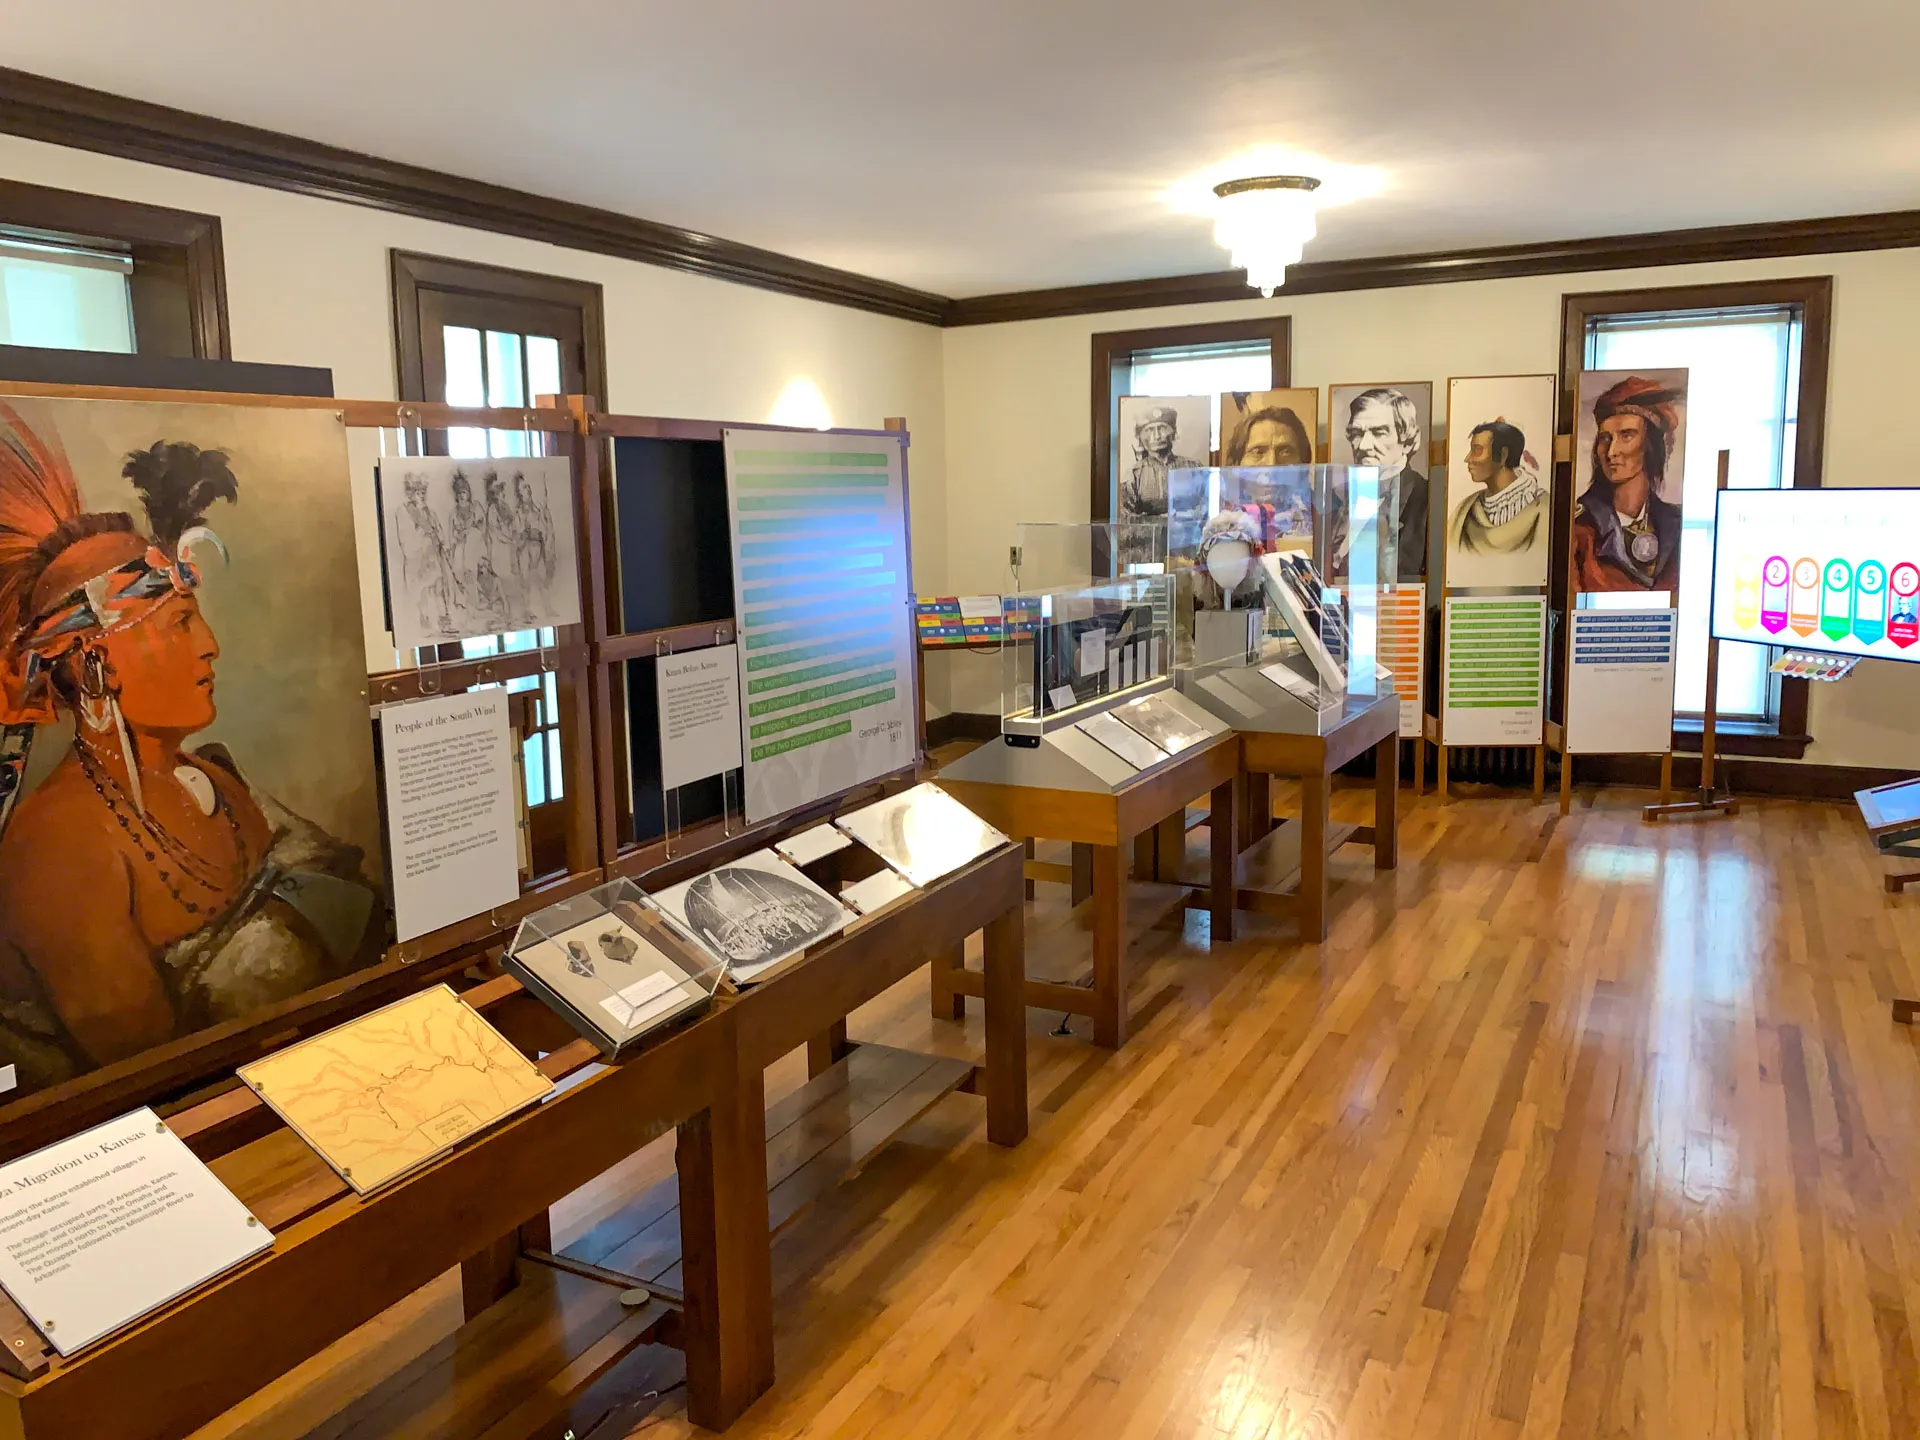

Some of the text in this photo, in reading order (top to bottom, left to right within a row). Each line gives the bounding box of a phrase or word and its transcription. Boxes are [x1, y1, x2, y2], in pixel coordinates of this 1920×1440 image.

[1773, 565, 1779, 578] 2
[1804, 567, 1809, 581] 3
[1833, 568, 1842, 582] 4
[1867, 570, 1875, 585] 5
[1901, 572, 1910, 587] 6
[395, 704, 496, 734] People of the South Wind
[859, 726, 880, 739] George
[890, 731, 902, 742] 1811
[13, 1157, 83, 1190] Migration
[84, 1150, 98, 1161] to
[98, 1130, 146, 1154] Kansas
[28, 1201, 42, 1210] the
[43, 1190, 68, 1204] Kanza
[68, 1171, 110, 1193] established
[111, 1160, 138, 1175] villages
[52, 1231, 68, 1242] and
[110, 1205, 125, 1214] The
[125, 1192, 152, 1207] Omaha
[154, 1184, 168, 1194] and
[5, 1242, 22, 1252] The
[22, 1230, 48, 1244] Osage
[50, 1212, 85, 1233] occupied
[86, 1203, 106, 1217] parts
[107, 1198, 115, 1206] of
[19, 1253, 45, 1268] Ponca
[46, 1240, 74, 1255] moved
[74, 1228, 97, 1242] north
[97, 1224, 107, 1232] to
[106, 1207, 142, 1226] Nebraska
[142, 1200, 156, 1210] and
[26, 1265, 42, 1275] The
[44, 1248, 78, 1268] Quapaw
[78, 1231, 112, 1251] followed
[112, 1225, 126, 1234] the
[126, 1206, 166, 1227] Mississippi
[166, 1196, 184, 1208] River
